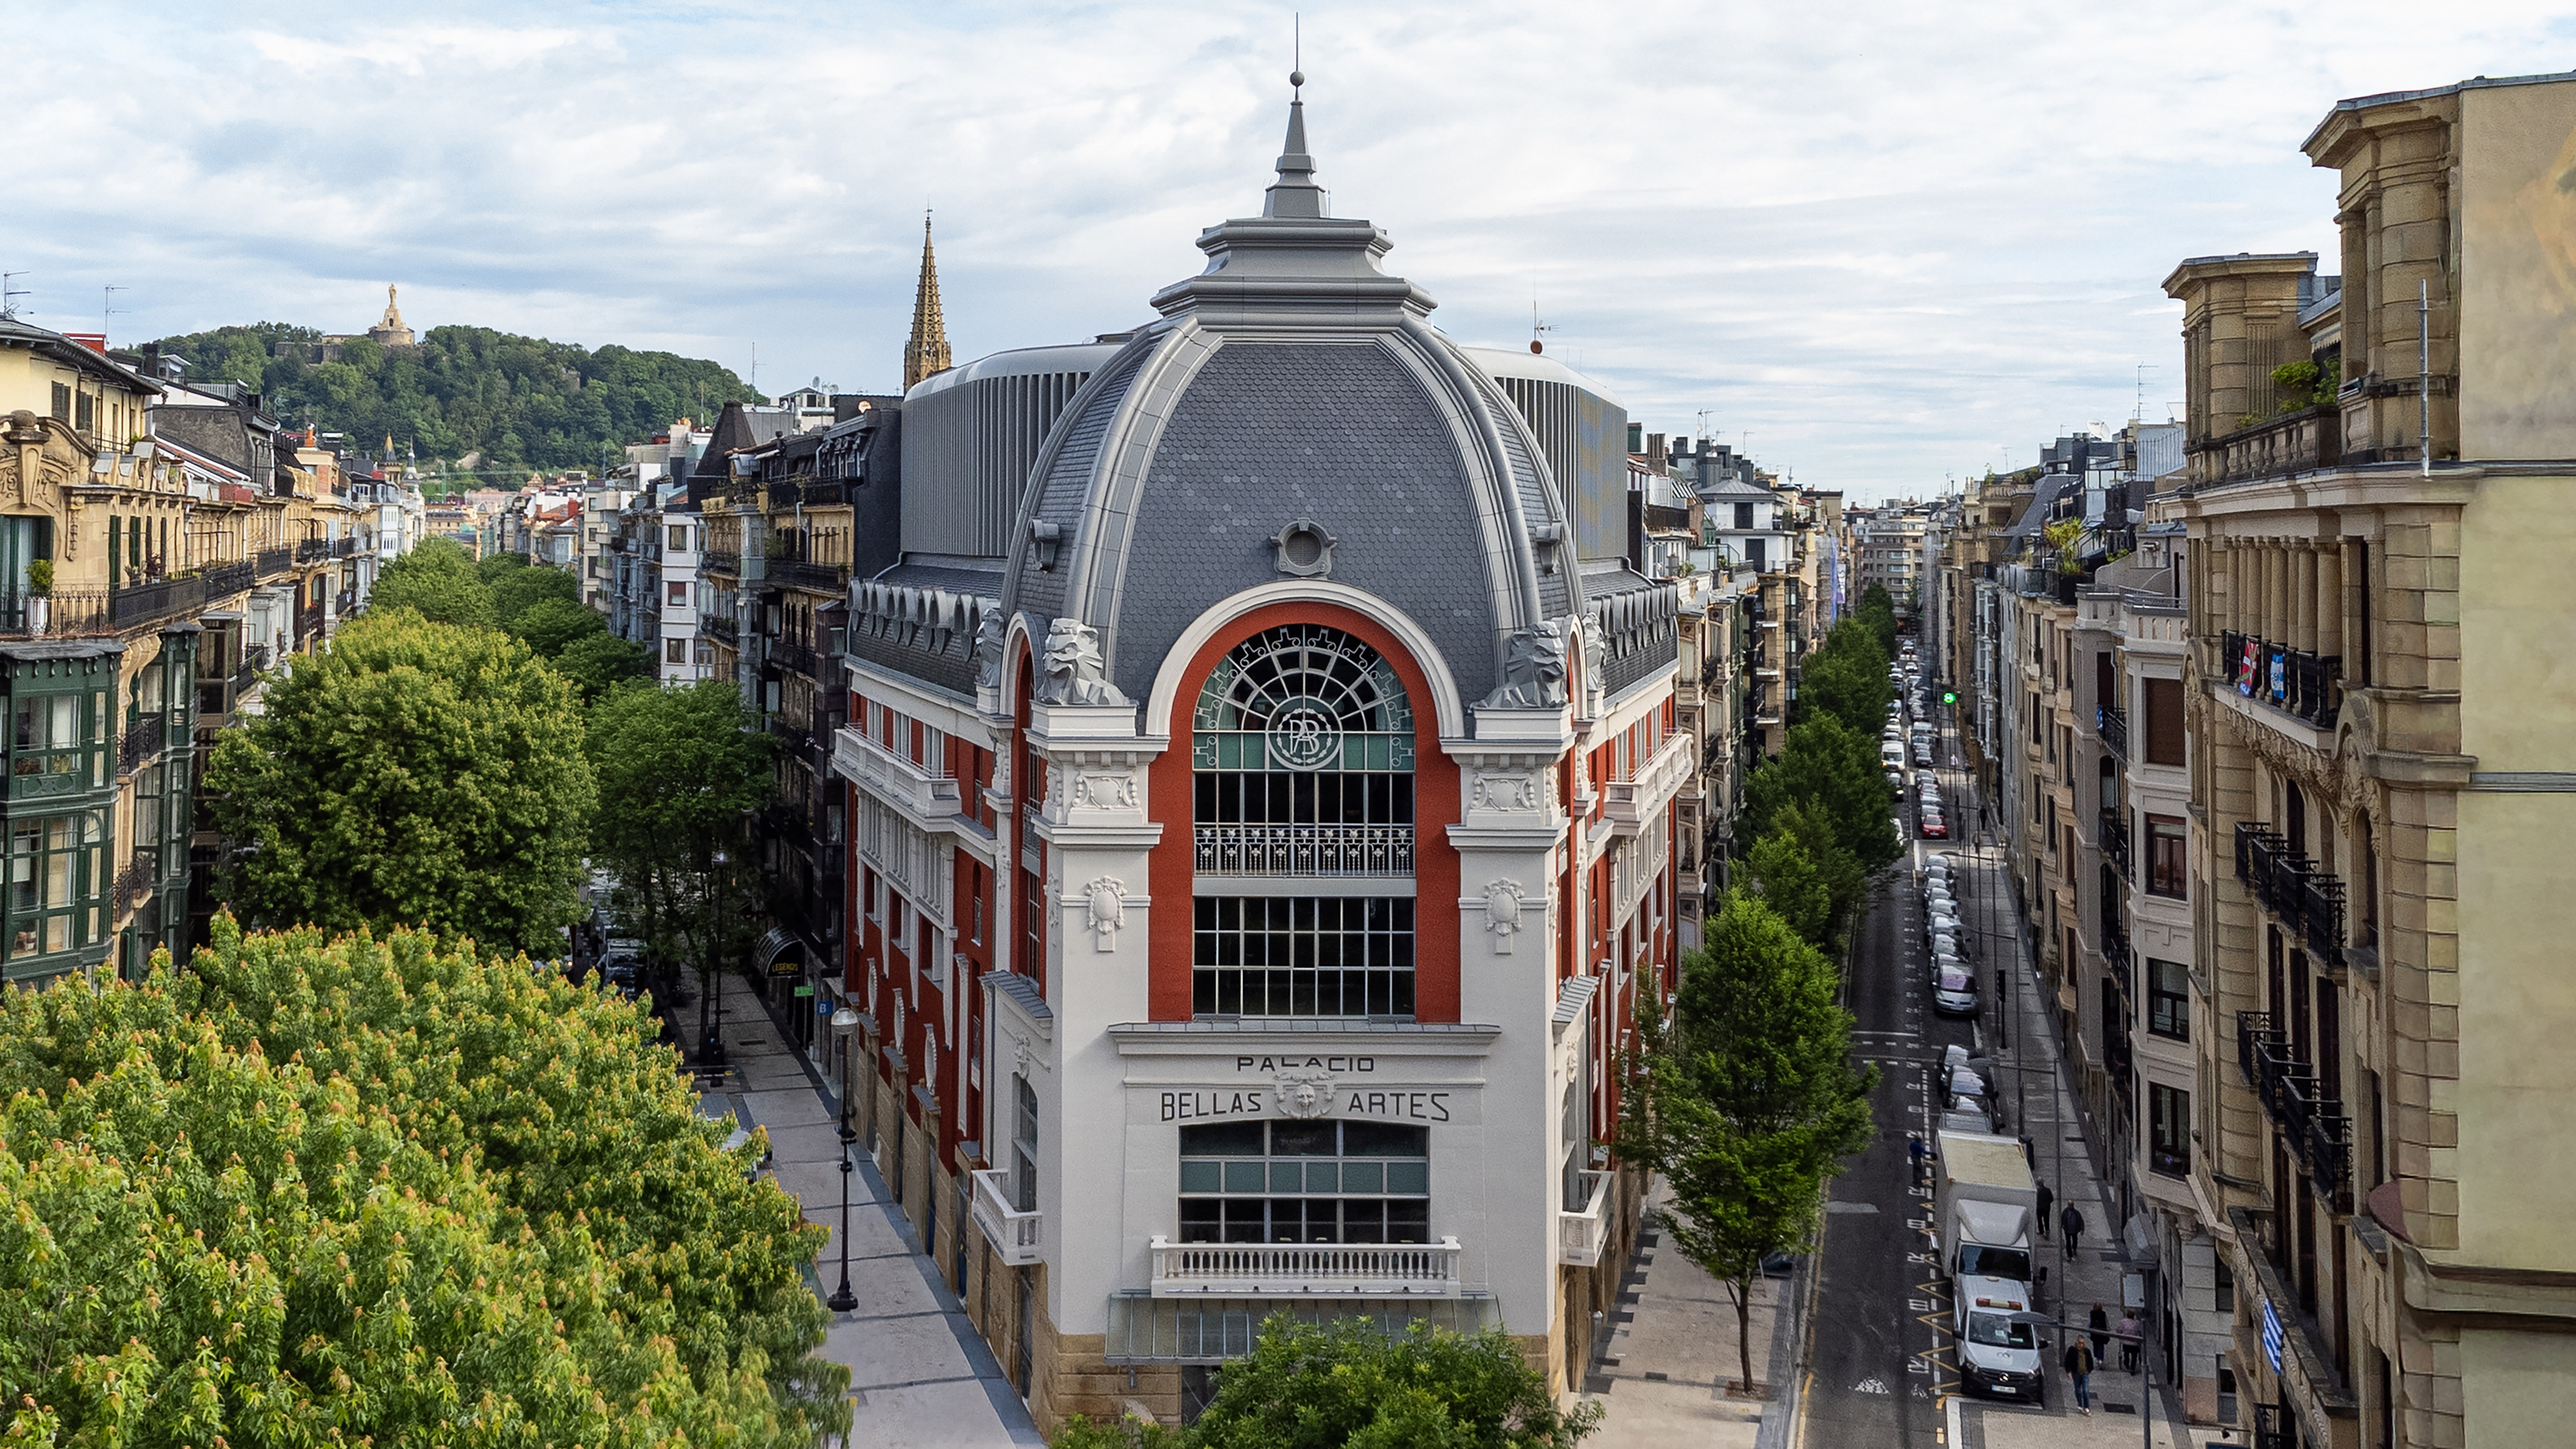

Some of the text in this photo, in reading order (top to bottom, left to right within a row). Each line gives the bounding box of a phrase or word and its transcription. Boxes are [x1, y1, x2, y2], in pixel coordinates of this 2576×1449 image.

[772, 963, 798, 972] LEGENDS
[1238, 1057, 1374, 1071] PALACIO
[1161, 1093, 1449, 1122] BELLAS ARTES
